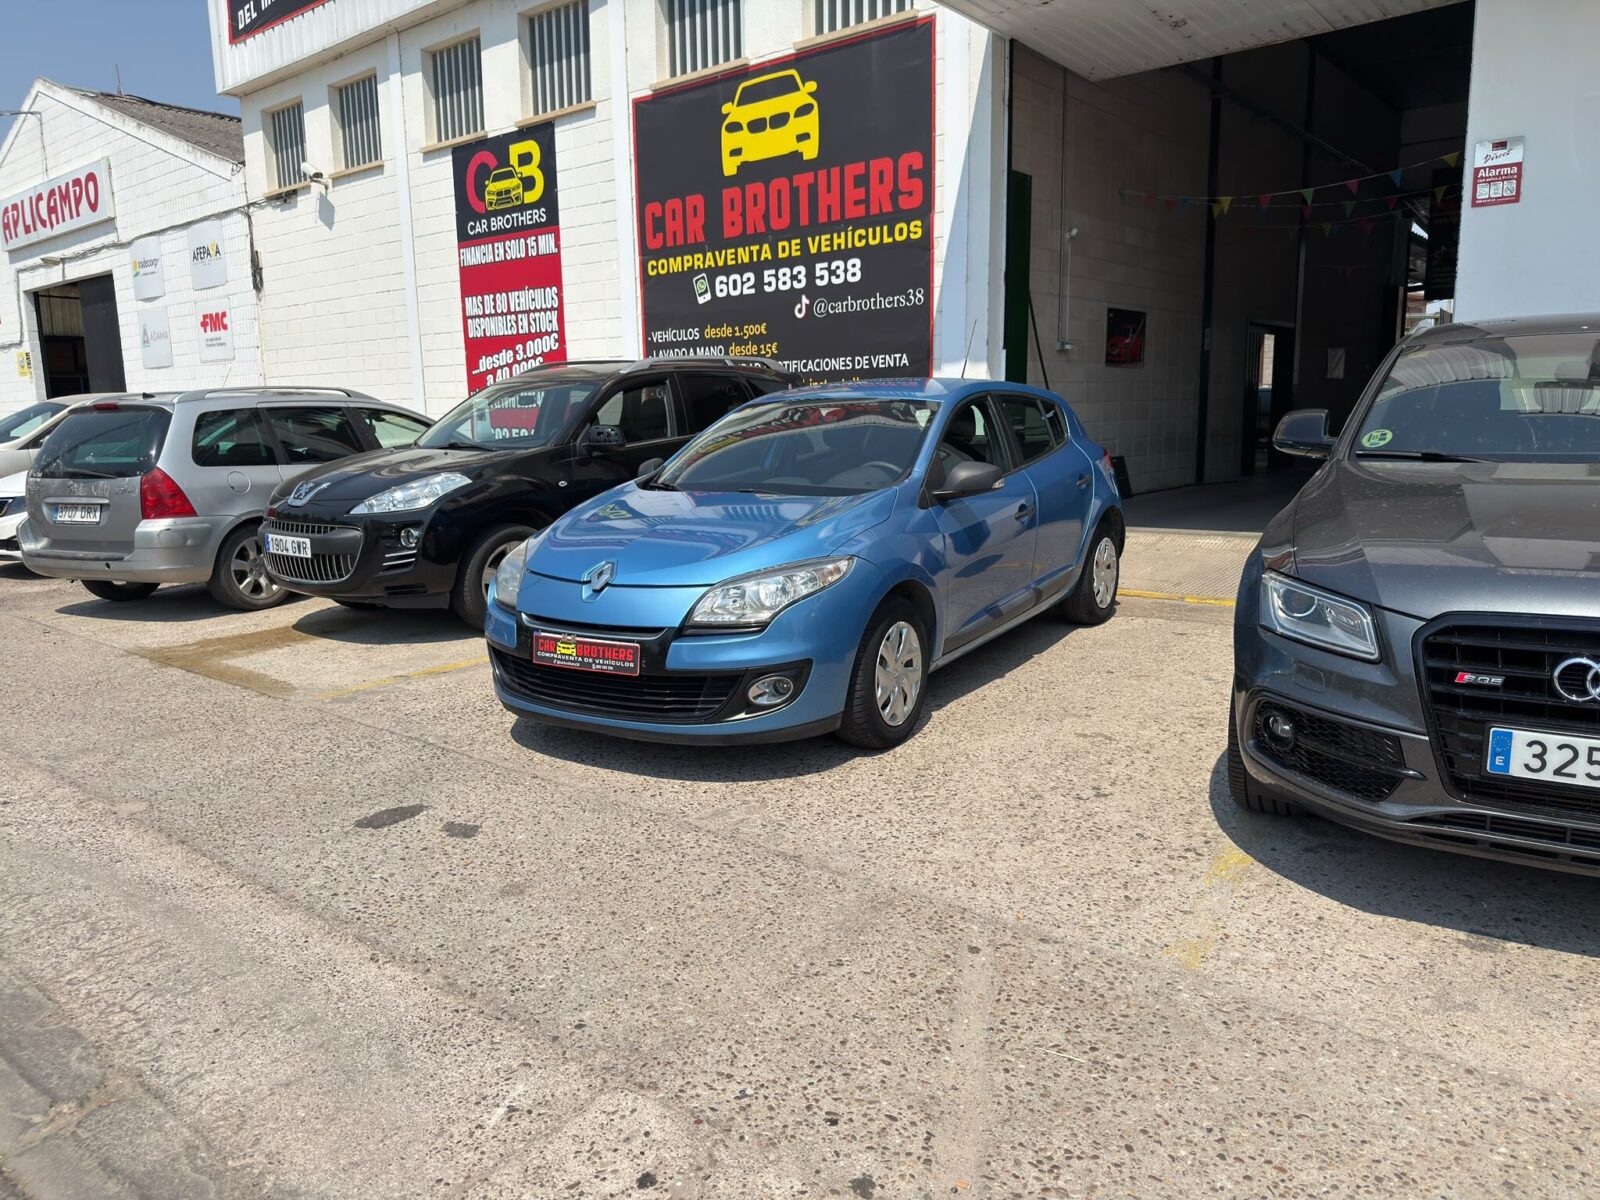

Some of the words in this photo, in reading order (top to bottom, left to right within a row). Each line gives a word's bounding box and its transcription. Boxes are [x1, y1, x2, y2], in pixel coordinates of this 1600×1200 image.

[238, 1, 257, 30] DEL
[1478, 166, 1517, 178] Alarma
[2, 172, 99, 245] APLICAMPO
[644, 192, 706, 250] CAR
[722, 151, 924, 239] BROTHERS
[468, 220, 488, 235] CAR
[490, 208, 546, 231] BROTHERS
[460, 244, 494, 267] FINANCIA
[494, 240, 504, 262] EN
[505, 238, 525, 260] SOLO
[527, 236, 537, 256] 15
[538, 233, 558, 255] MIN.
[648, 243, 772, 276] COMPRAVENTA
[778, 239, 801, 258] DE
[808, 220, 923, 254] VEHÍCULOS
[715, 272, 756, 298] 602
[763, 265, 806, 293] 583
[815, 258, 862, 286] 538
[465, 296, 483, 316] MAS
[484, 294, 495, 315] DE
[496, 292, 507, 313] 80
[508, 285, 558, 312] VEHÍCULOS
[813, 287, 924, 318] @carbrothers38
[200, 311, 228, 333] FMC
[468, 315, 516, 338] DISPONIBLES
[518, 312, 528, 335] EN
[530, 310, 559, 334] STOCK
[652, 328, 699, 342] VEHÍCULOS
[704, 323, 732, 339] desde
[734, 323, 767, 339] 1.500€
[472, 349, 513, 375] ...desde
[516, 333, 559, 361] 3.000€
[654, 348, 687, 358] LAVADO
[689, 348, 695, 356] A
[696, 346, 724, 356] MANO
[729, 341, 757, 357] desde
[760, 342, 778, 357] 15€
[778, 357, 851, 372] TIFICACIONES
[855, 355, 869, 369] DE
[871, 353, 909, 368] VENTA
[486, 373, 494, 387] a
[81, 506, 97, 519] DRX
[271, 537, 289, 553] 1904
[537, 652, 582, 662] COMPRAVENTA
[595, 658, 634, 667] VEHÍCULOS
[538, 639, 556, 652] CAR
[576, 644, 633, 660] BROTHERS
[1464, 675, 1502, 686] SQ5
[1496, 756, 1504, 765] E
[1524, 740, 1600, 781] 325
